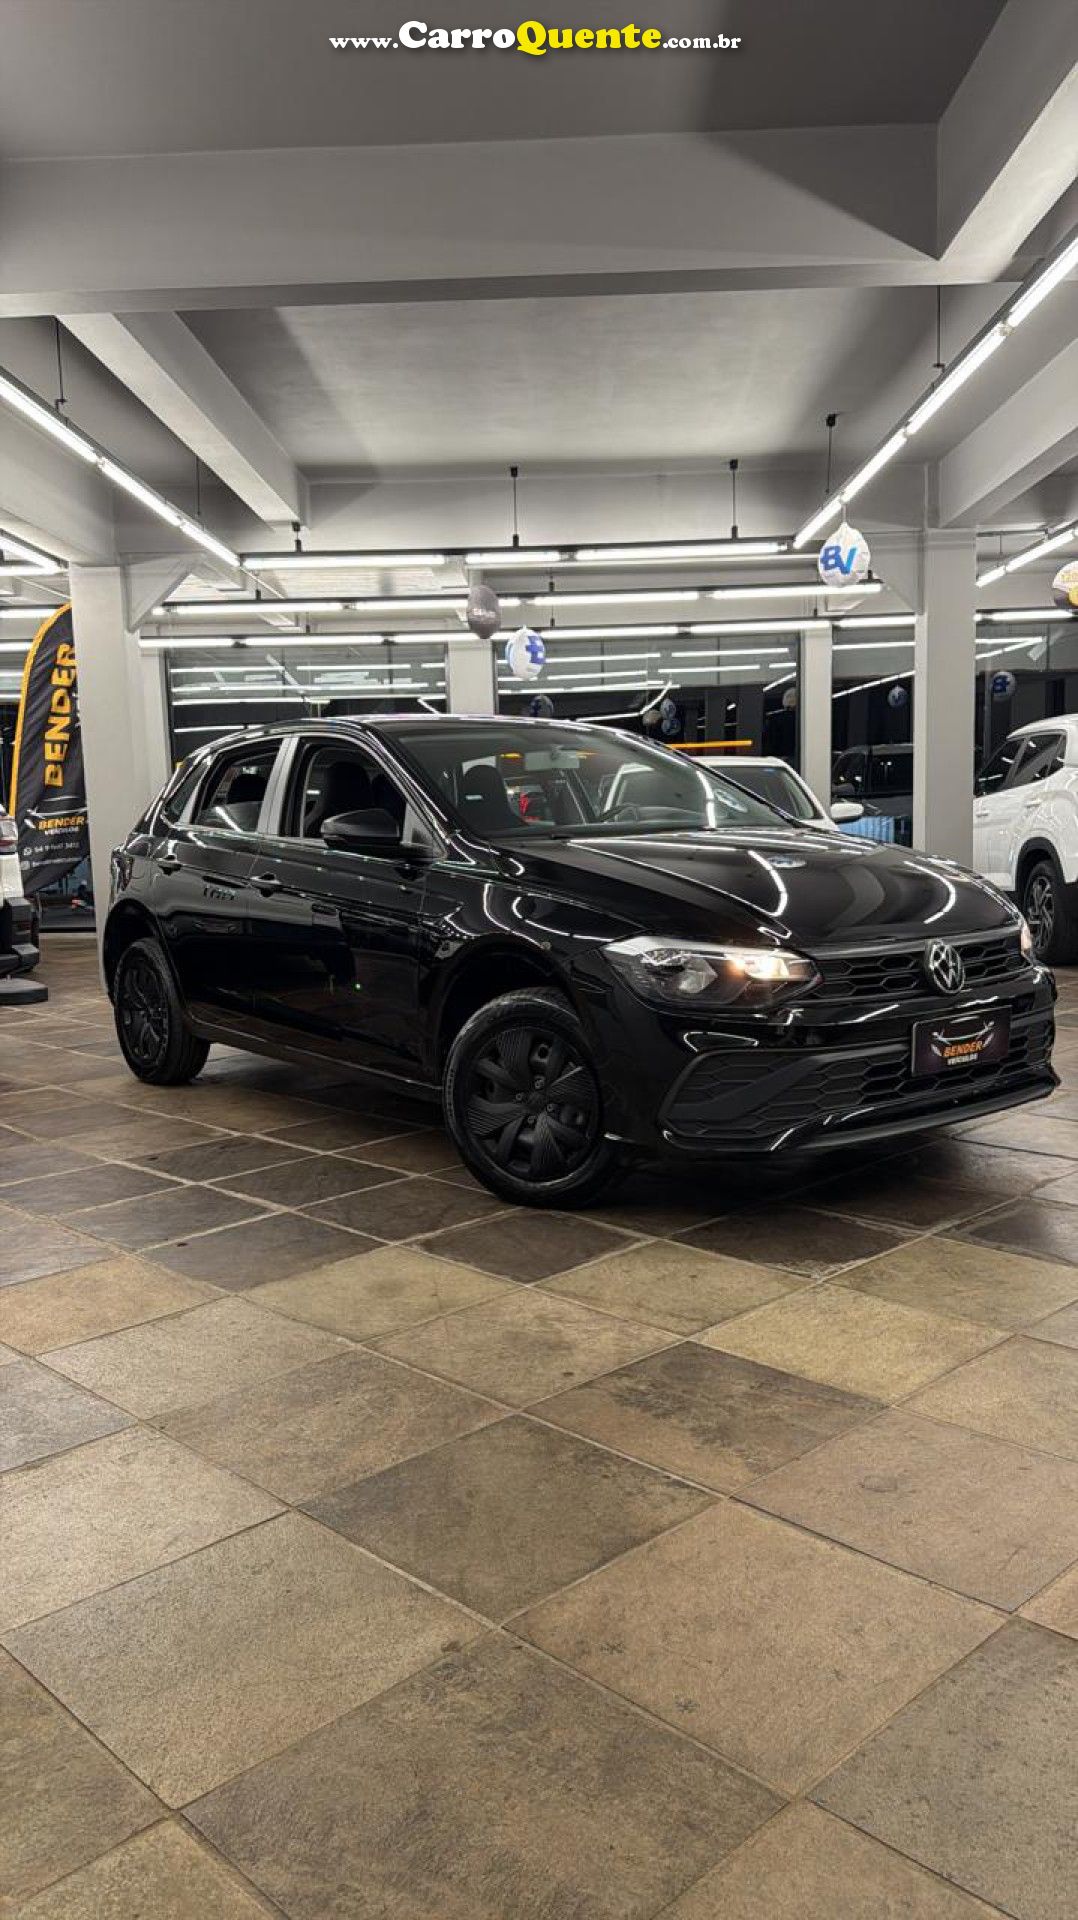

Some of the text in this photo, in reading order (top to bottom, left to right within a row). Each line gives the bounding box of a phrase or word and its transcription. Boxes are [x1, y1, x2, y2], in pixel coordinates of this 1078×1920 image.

[44, 643, 78, 787] BENDER
[38, 815, 85, 831] BENDER
[943, 1040, 983, 1057] BENDER
